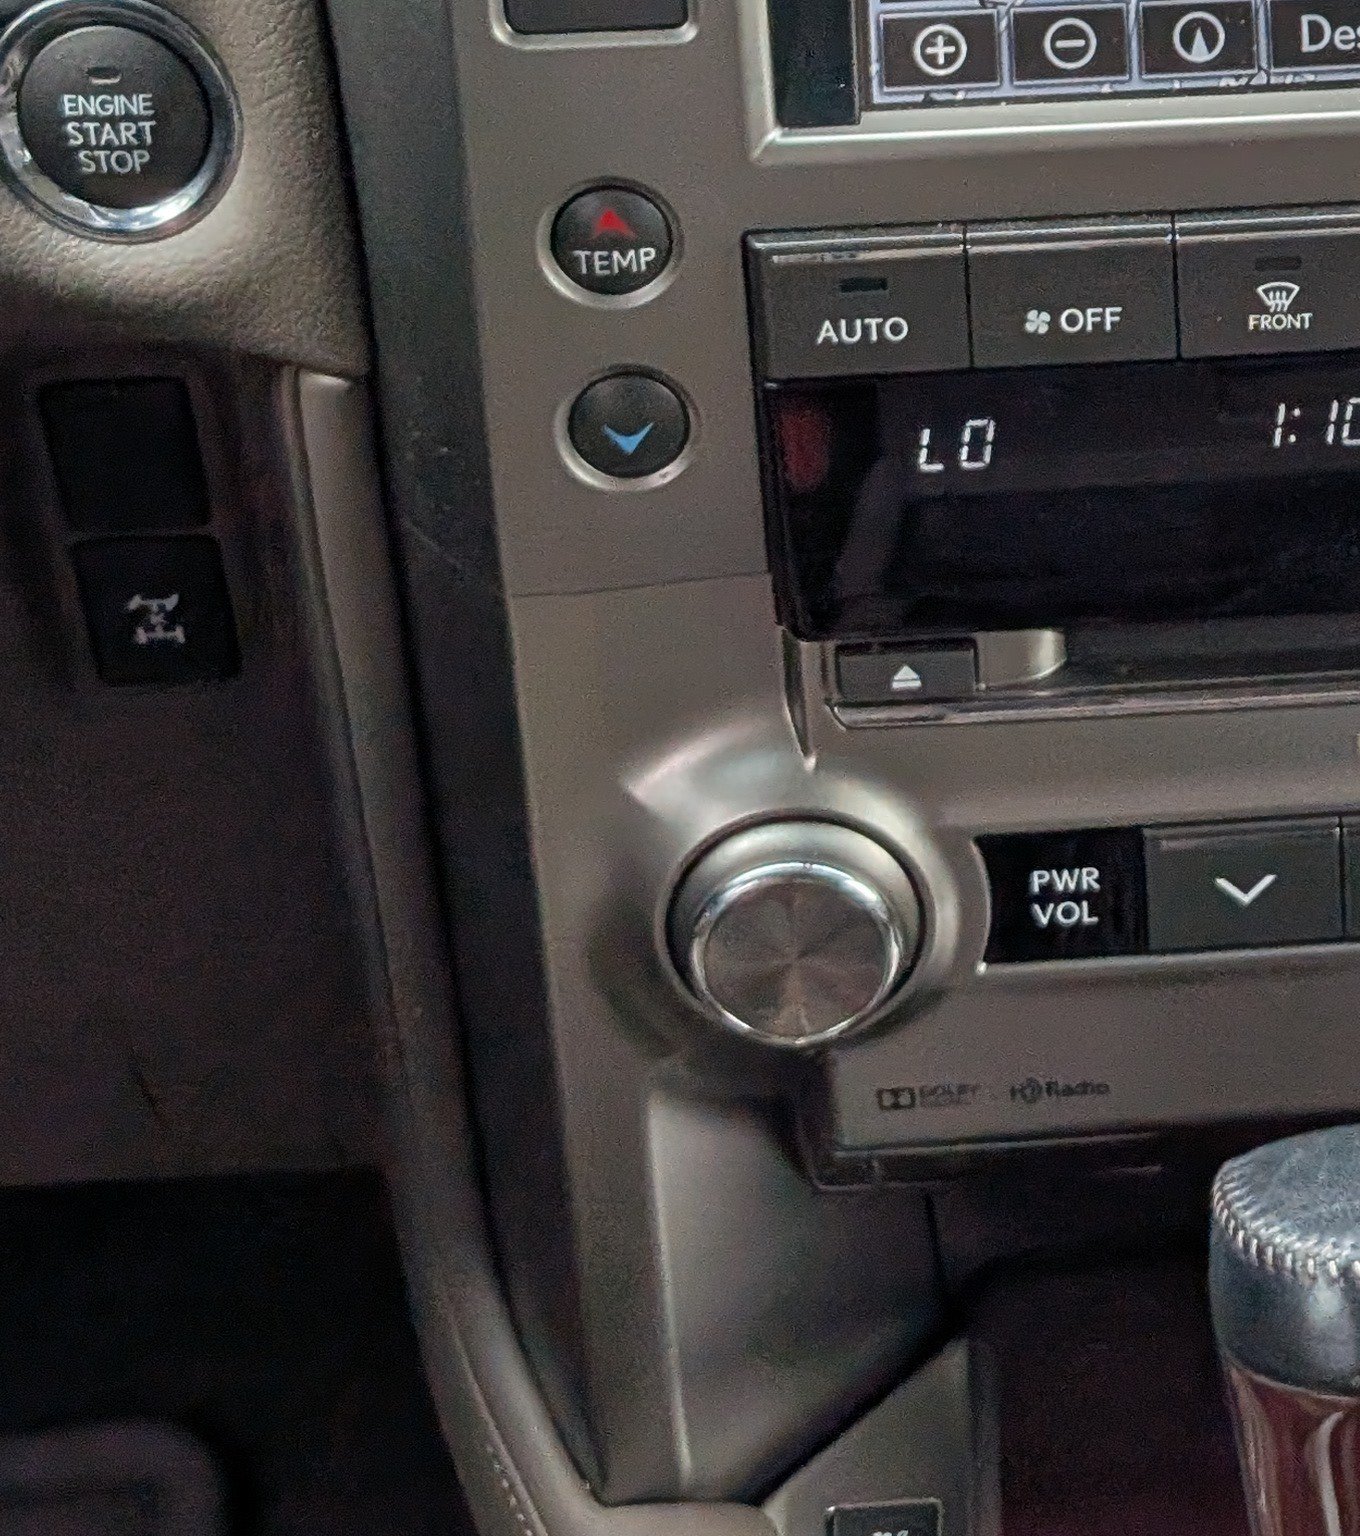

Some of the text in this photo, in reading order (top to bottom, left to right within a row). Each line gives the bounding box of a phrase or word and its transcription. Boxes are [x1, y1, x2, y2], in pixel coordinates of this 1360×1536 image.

[62, 93, 156, 117] ENGINE
[66, 120, 157, 147] START
[78, 149, 151, 174] STOP
[573, 246, 657, 277] TEMP
[817, 316, 910, 346] AUTO
[1059, 307, 1123, 334] OFF
[1247, 312, 1314, 331] FRONT
[917, 417, 997, 473] LO
[1029, 866, 1101, 894] PWR
[1030, 900, 1100, 928] VOL
